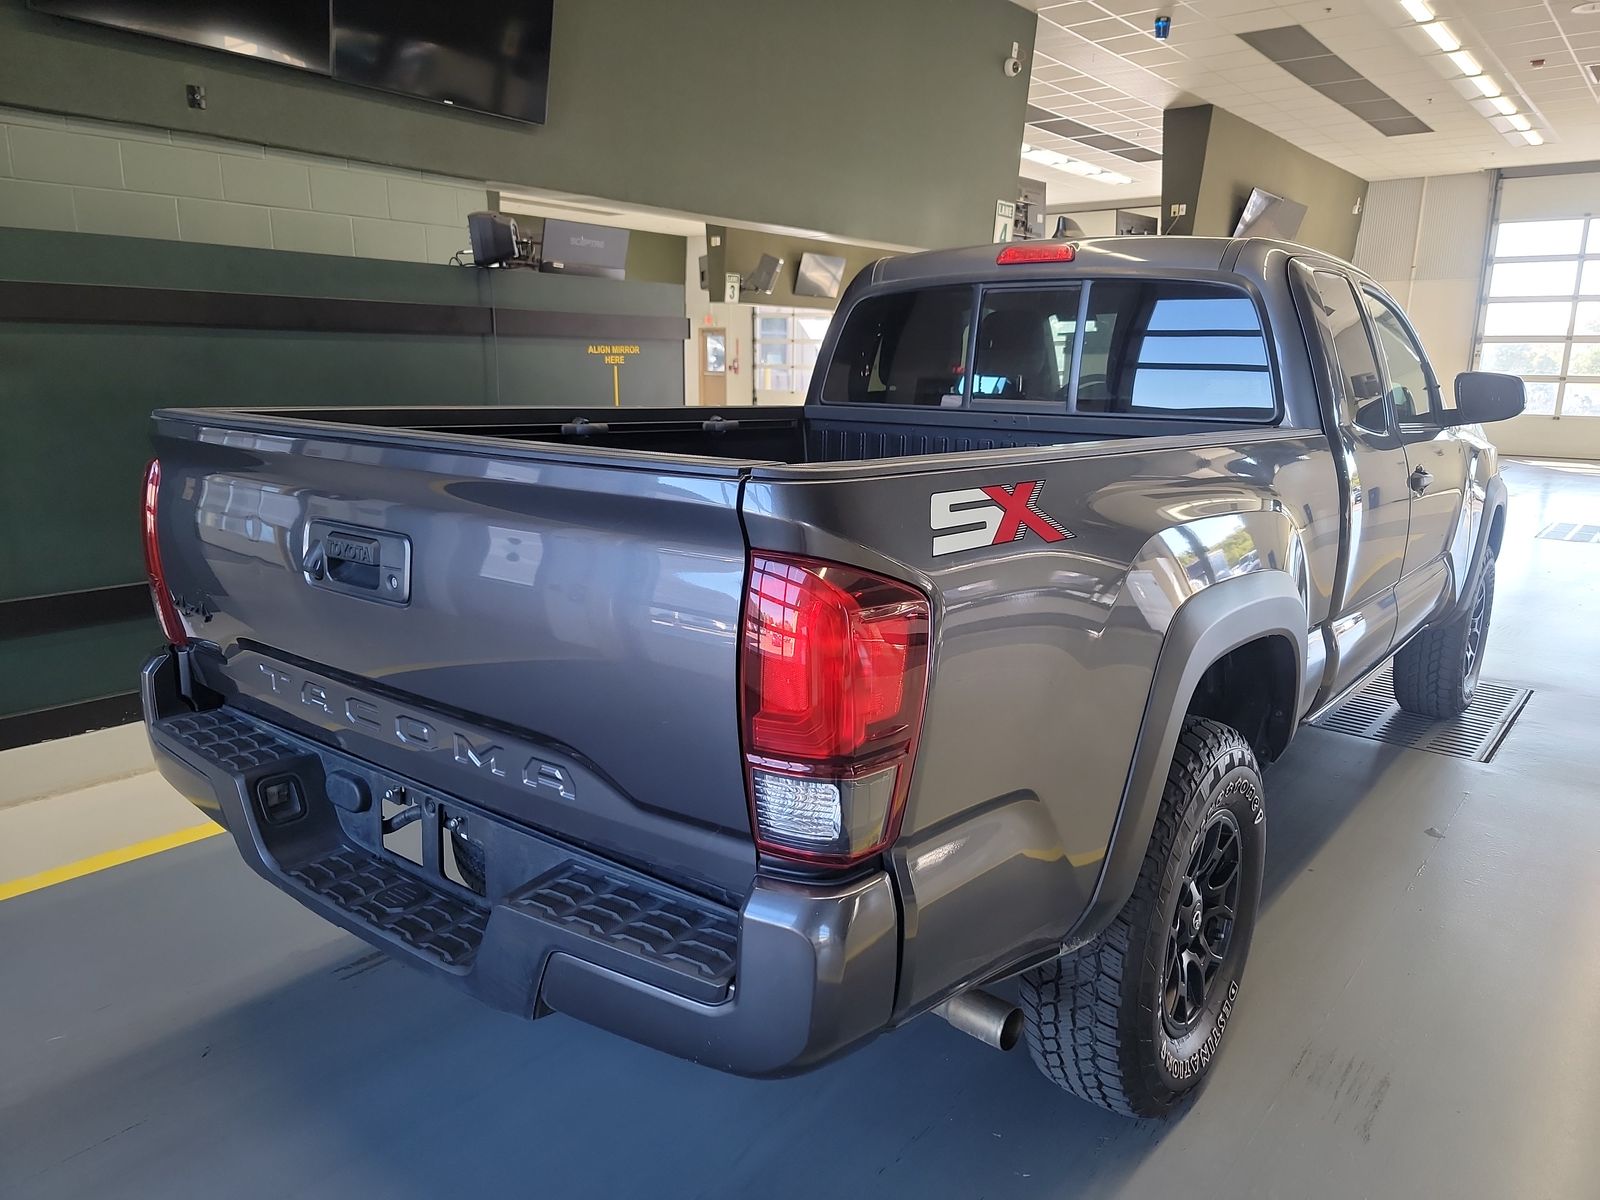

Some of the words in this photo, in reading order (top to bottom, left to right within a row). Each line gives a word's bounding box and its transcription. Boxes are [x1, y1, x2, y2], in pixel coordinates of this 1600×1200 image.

[729, 285, 736, 300] 3
[588, 345, 611, 354] ALIGN
[612, 345, 640, 354] MIRROR
[604, 355, 625, 364] HERE
[930, 479, 1077, 558] SX
[329, 541, 375, 565] TOYOTA
[256, 663, 576, 801] TACOMA
[1165, 980, 1239, 1079] DESTINATION
